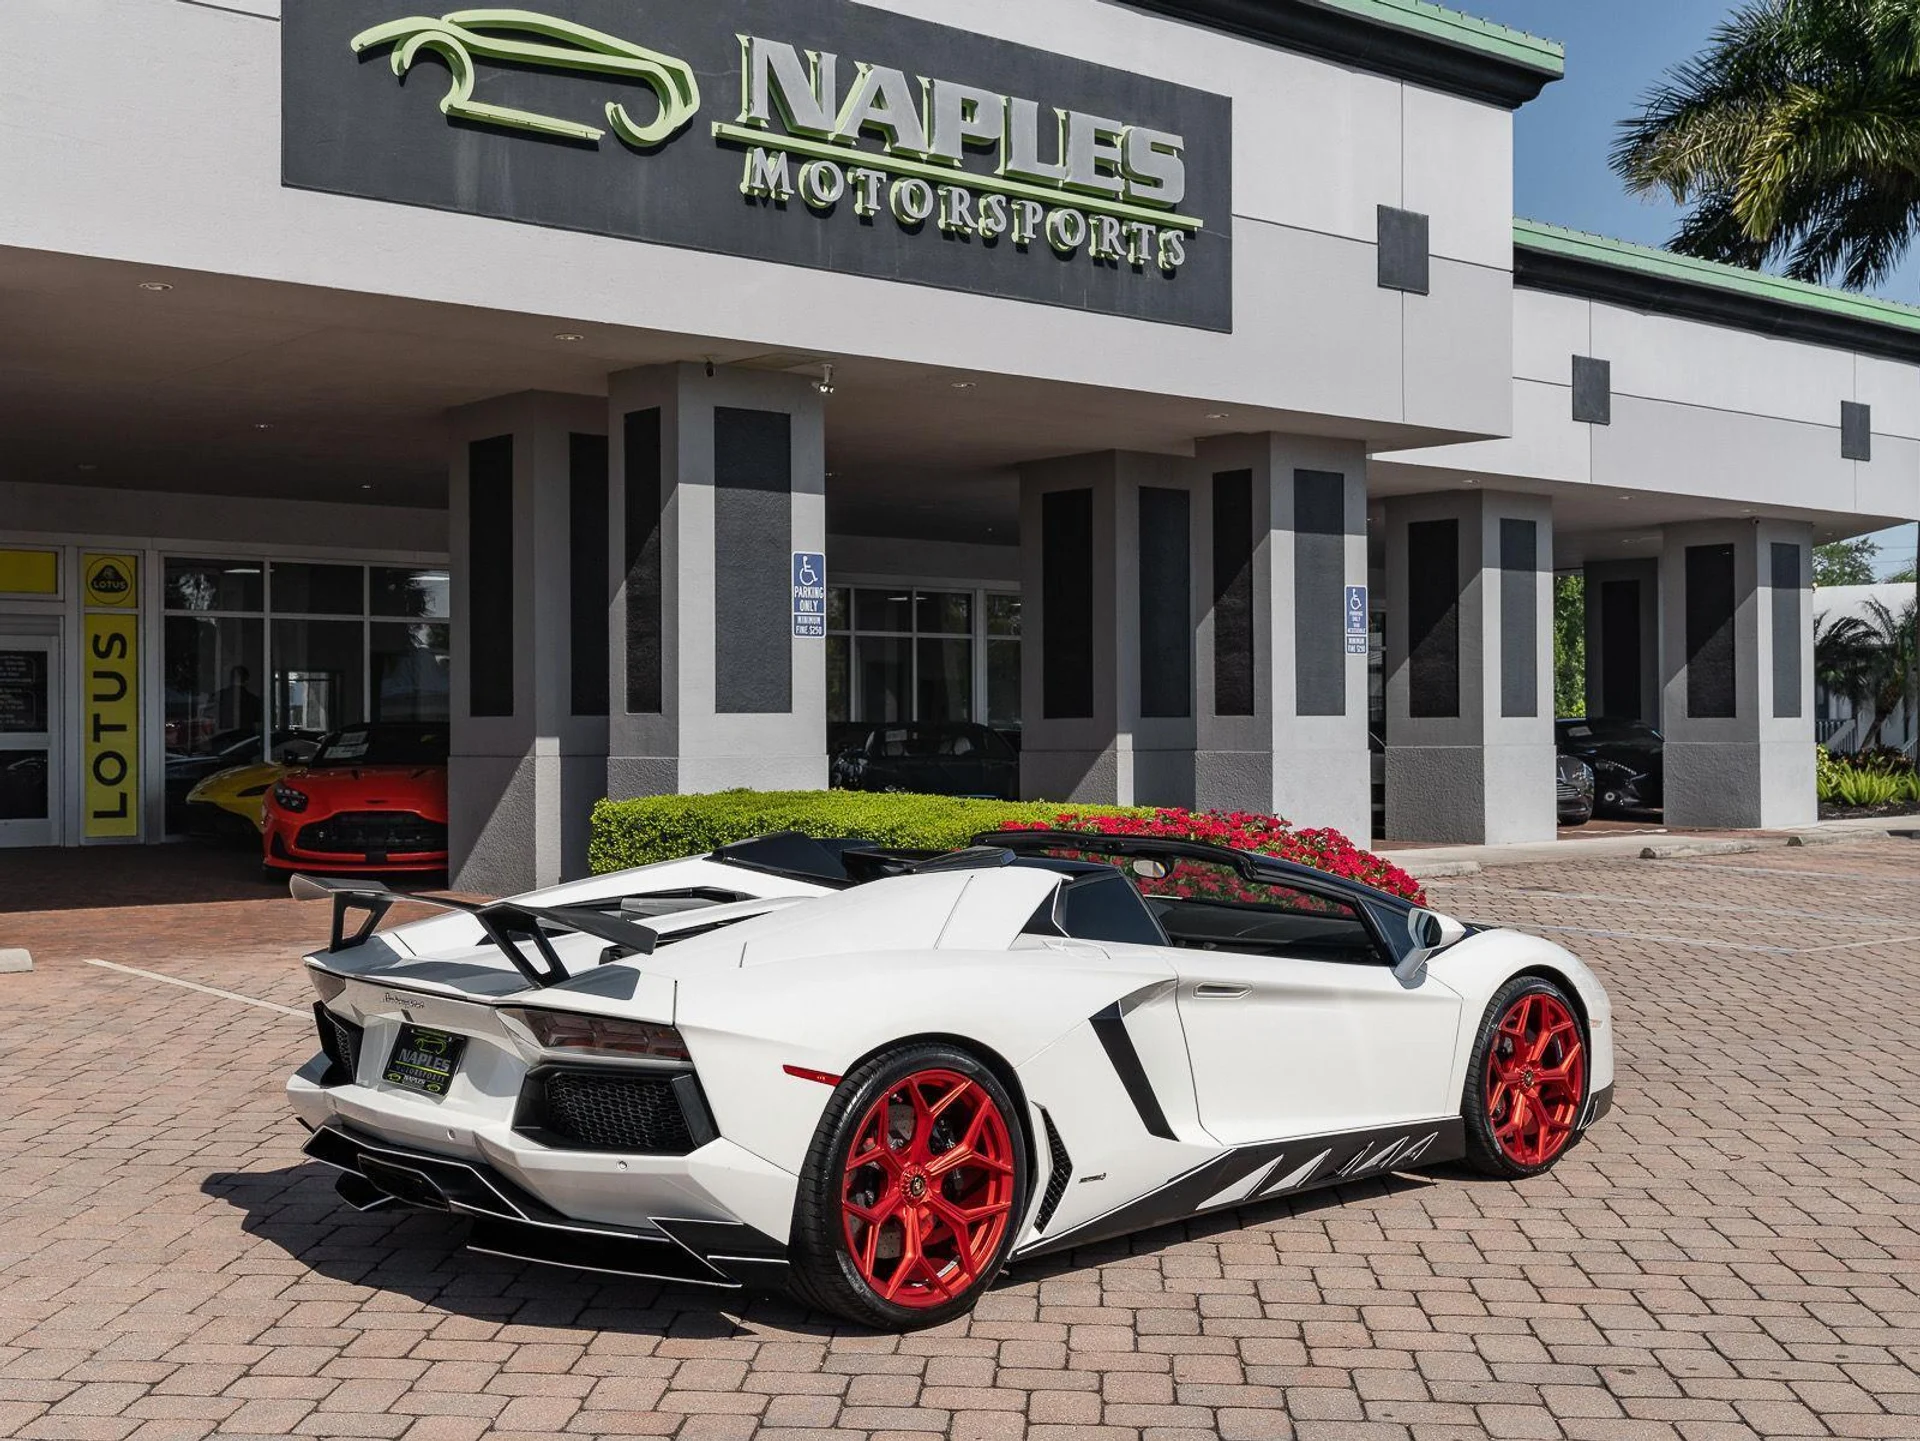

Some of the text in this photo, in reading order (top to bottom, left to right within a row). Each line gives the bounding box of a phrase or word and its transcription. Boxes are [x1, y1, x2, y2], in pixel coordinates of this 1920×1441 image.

[735, 33, 1186, 207] NAPLES
[739, 147, 1186, 270] MOTORSPORTS
[93, 580, 126, 589] LOTUS
[794, 585, 824, 599] PARKING
[799, 599, 818, 612] ONLY
[92, 632, 128, 819] LOTUS
[398, 1048, 452, 1073] NAPLES
